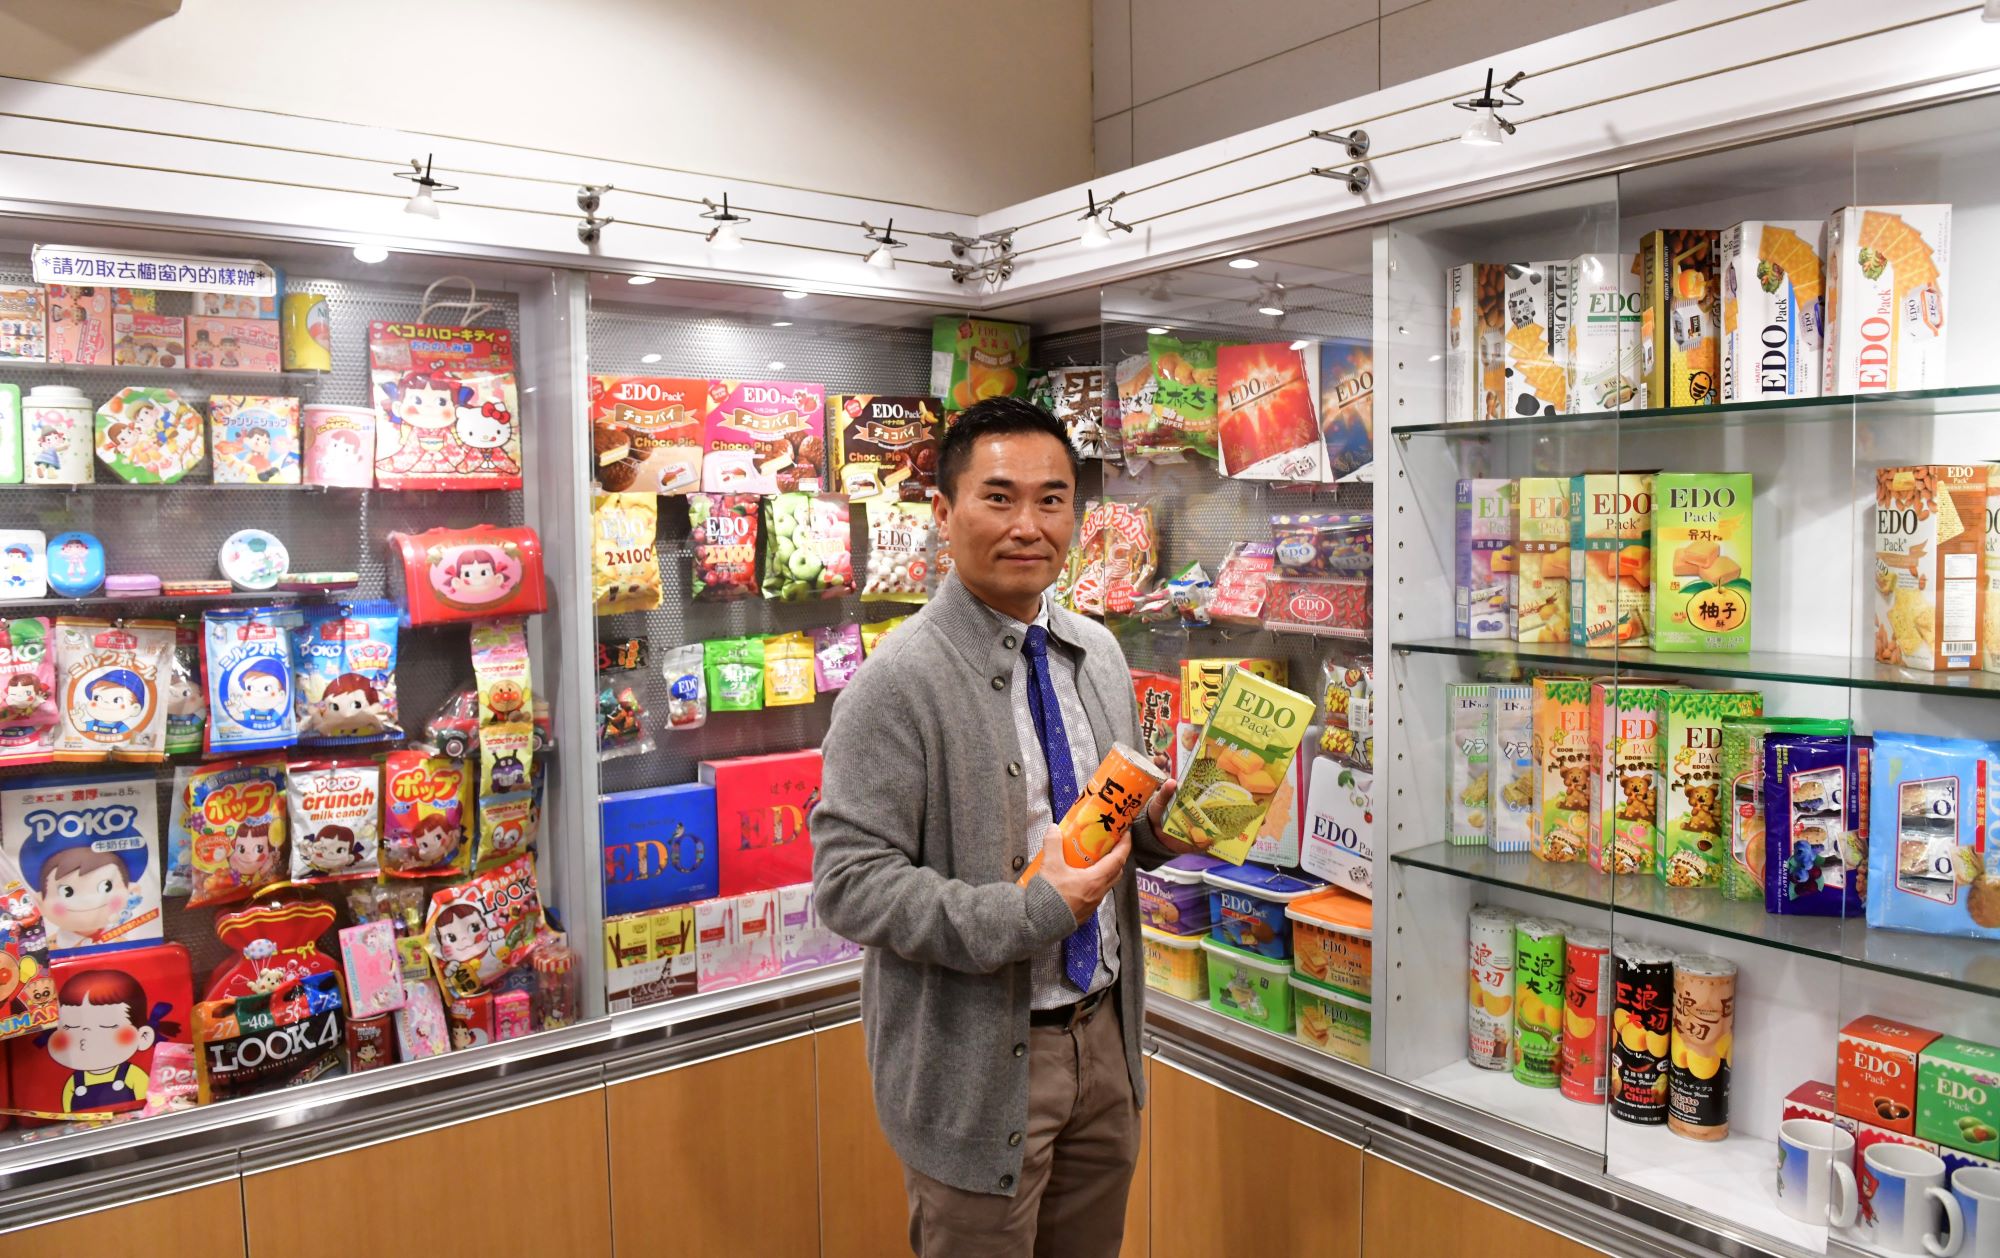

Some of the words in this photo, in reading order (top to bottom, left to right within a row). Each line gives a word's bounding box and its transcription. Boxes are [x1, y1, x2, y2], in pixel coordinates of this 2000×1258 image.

[1761, 324, 1787, 392] EDO
[1775, 299, 1788, 322] Pack
[1859, 317, 1890, 390] EDO
[1877, 289, 1891, 314] Pack
[621, 384, 661, 400] EDO
[662, 392, 682, 401] Pack
[743, 387, 780, 403] EDO
[1228, 377, 1261, 407] EDO
[1335, 370, 1373, 403] EDO
[872, 403, 904, 418] EDO
[635, 437, 673, 447] Choco
[678, 437, 697, 447] Pie
[711, 440, 751, 451] Choco
[754, 441, 773, 451] Pie
[849, 452, 882, 461] Choco
[885, 452, 901, 461] Pie
[1947, 466, 1974, 477] EDO
[1592, 493, 1651, 514] EDO
[1669, 487, 1736, 508] EDO
[1528, 497, 1570, 519] ED
[1683, 511, 1718, 523] Pack
[601, 518, 645, 539] EDO
[705, 516, 750, 536] EDO
[1606, 518, 1637, 530] Pack
[1877, 508, 1918, 535] EDO
[877, 529, 912, 547] EDO
[1687, 528, 1712, 541] 유자
[1883, 537, 1904, 551] Pack
[1297, 599, 1325, 610] EDO
[1699, 601, 1738, 620] 柚子
[1586, 619, 1612, 635] EDO
[1233, 688, 1296, 729] EDO
[1240, 716, 1270, 738] Pack
[1620, 719, 1659, 740] ED
[1686, 727, 1723, 748] ED
[1698, 753, 1721, 764] PAC
[395, 774, 460, 801] ポップ
[207, 785, 272, 820] ポップ
[303, 787, 374, 811] crunch
[310, 811, 334, 821] milk
[335, 808, 369, 819] candy
[738, 804, 812, 851] ED
[1313, 815, 1358, 849] EDO
[1359, 841, 1373, 857] Pa
[605, 832, 705, 885] EDO
[478, 876, 534, 916] LOOK
[1221, 893, 1253, 913] EDO
[1323, 938, 1347, 956] EDO
[1616, 980, 1670, 1012] E浪
[1675, 990, 1721, 1024] 浪
[248, 1013, 268, 1030] 40
[1626, 1010, 1668, 1030] 大切
[1873, 1022, 1910, 1038] EDO
[210, 1021, 317, 1073] LOOK
[317, 1010, 342, 1049] 4
[1954, 1043, 1996, 1059] EDO
[1853, 1051, 1901, 1078] EDO
[1864, 1072, 1886, 1086] Pack
[1937, 1077, 1988, 1105] EDO
[1948, 1099, 1971, 1113] Pack
